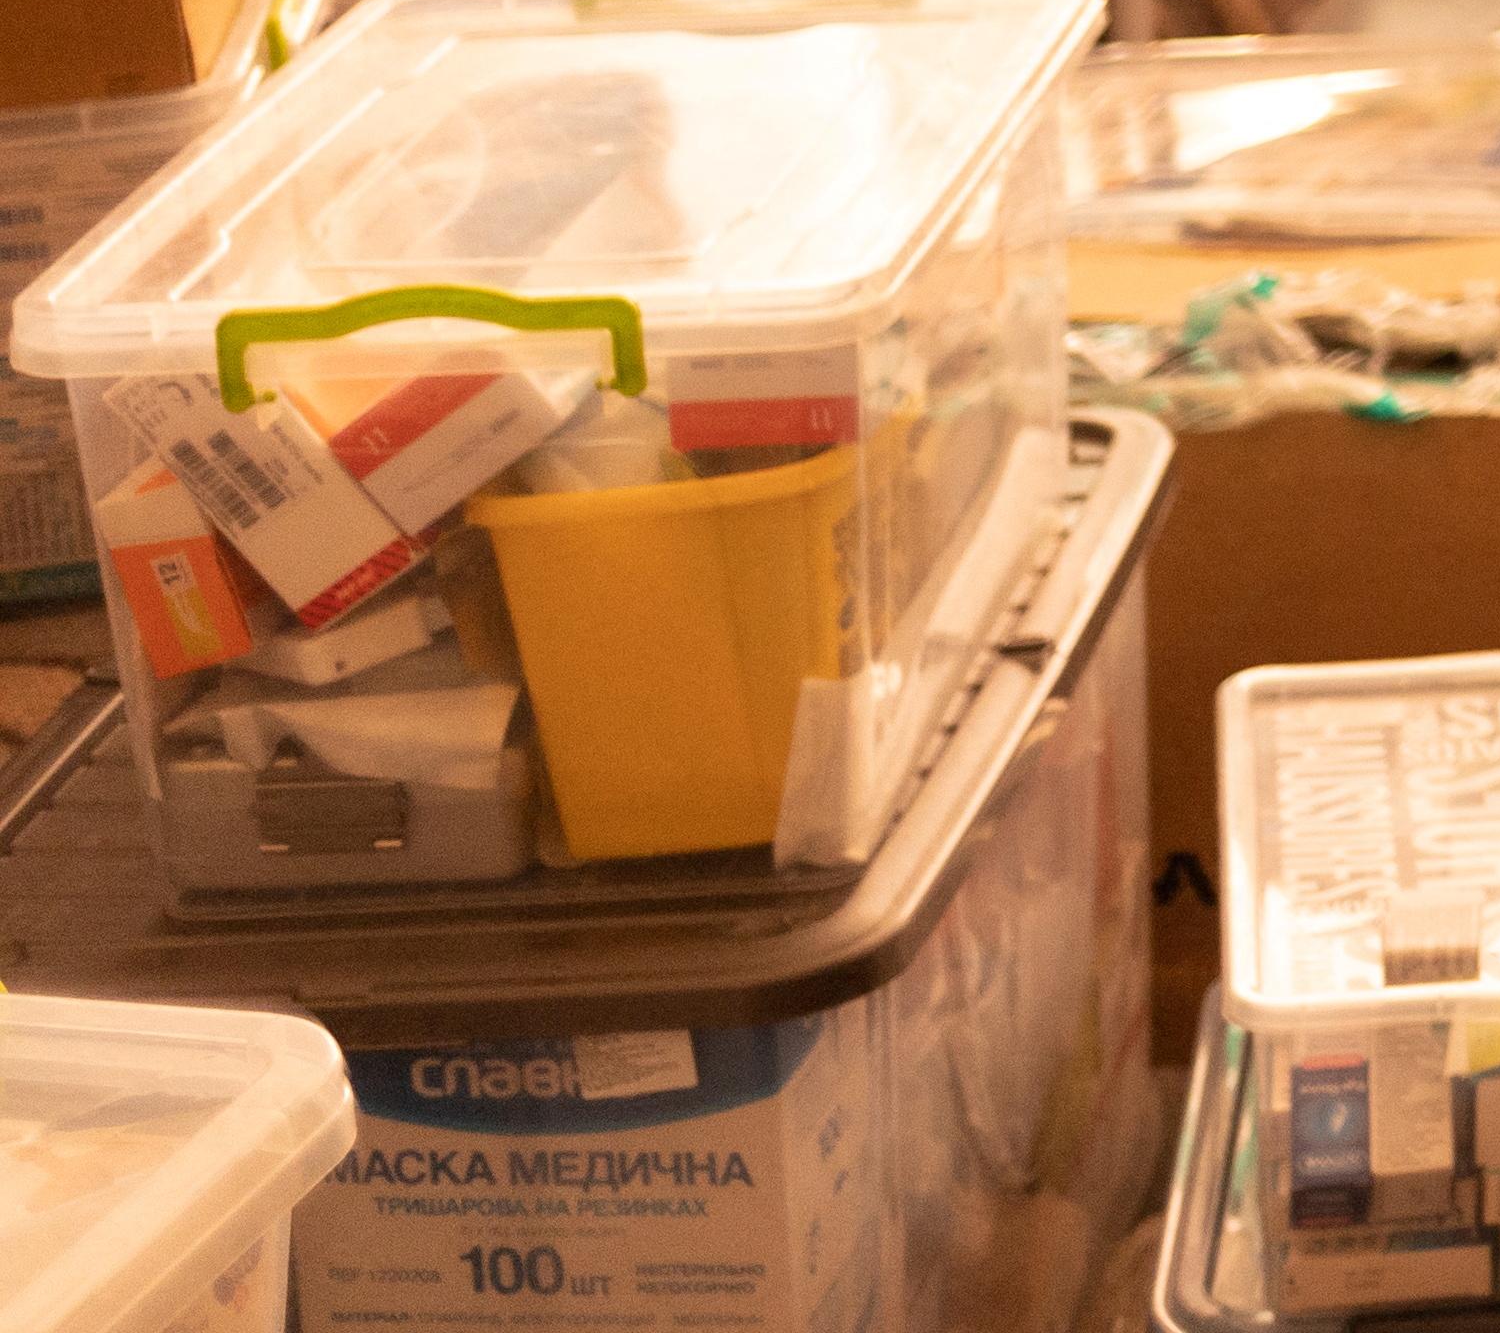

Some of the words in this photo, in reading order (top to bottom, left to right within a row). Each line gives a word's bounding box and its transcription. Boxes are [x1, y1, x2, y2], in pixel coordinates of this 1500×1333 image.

[508, 1149, 754, 1192] МЕДИЧНА
[373, 1196, 528, 1218] ТРИШАРОВА
[536, 1197, 568, 1217] НА
[577, 1196, 709, 1218] РЕЗИНКАХ
[458, 1245, 566, 1297] 100
